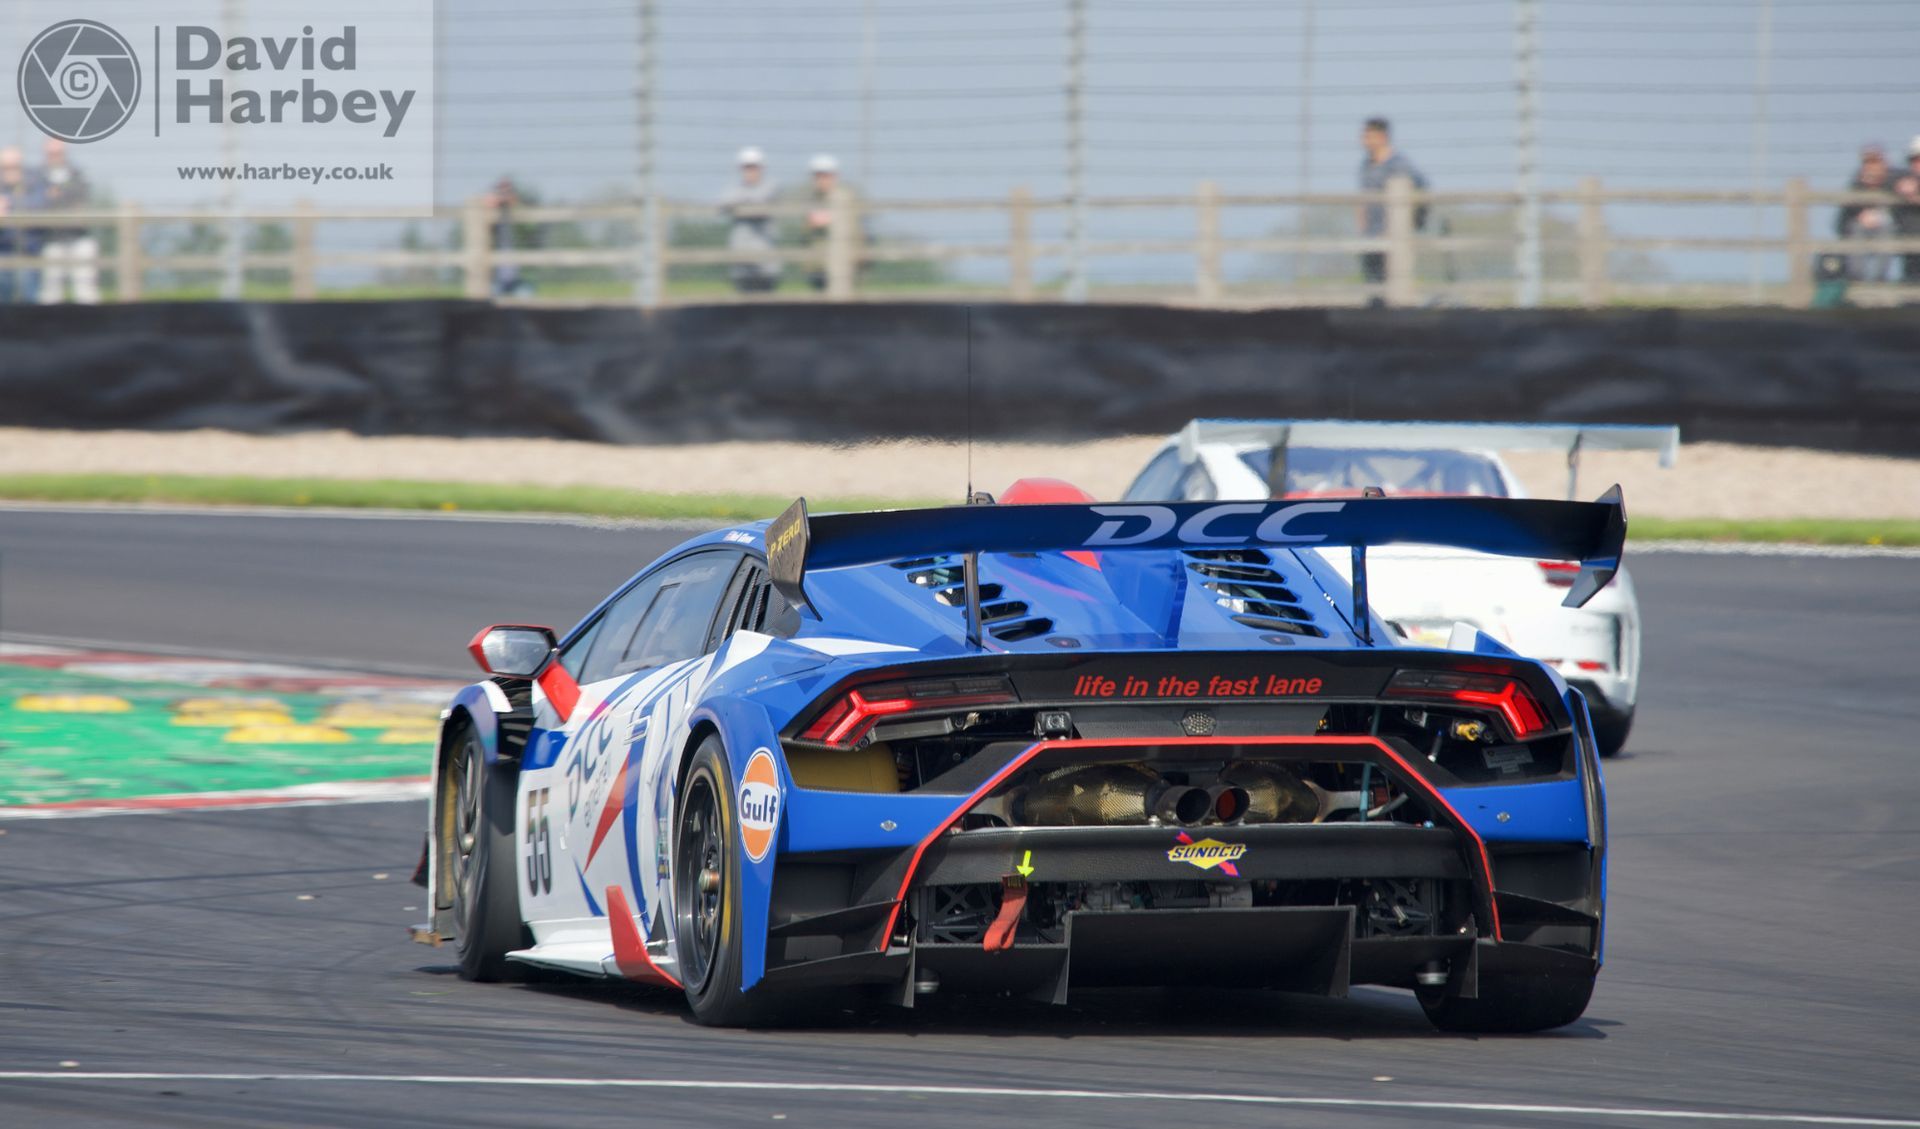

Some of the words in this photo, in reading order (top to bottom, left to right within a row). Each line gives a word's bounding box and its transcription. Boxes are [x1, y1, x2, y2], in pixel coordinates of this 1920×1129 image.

[770, 542, 777, 559] P
[777, 518, 801, 552] ZERO
[1081, 502, 1346, 546] DCC
[1074, 675, 1115, 696] life
[1123, 676, 1149, 696] in
[1157, 676, 1200, 696] the
[1207, 676, 1259, 696] fast
[1265, 675, 1322, 695] lane
[741, 787, 777, 823] Gulf
[526, 787, 552, 898] 55
[1171, 845, 1244, 858] SUNOCO
